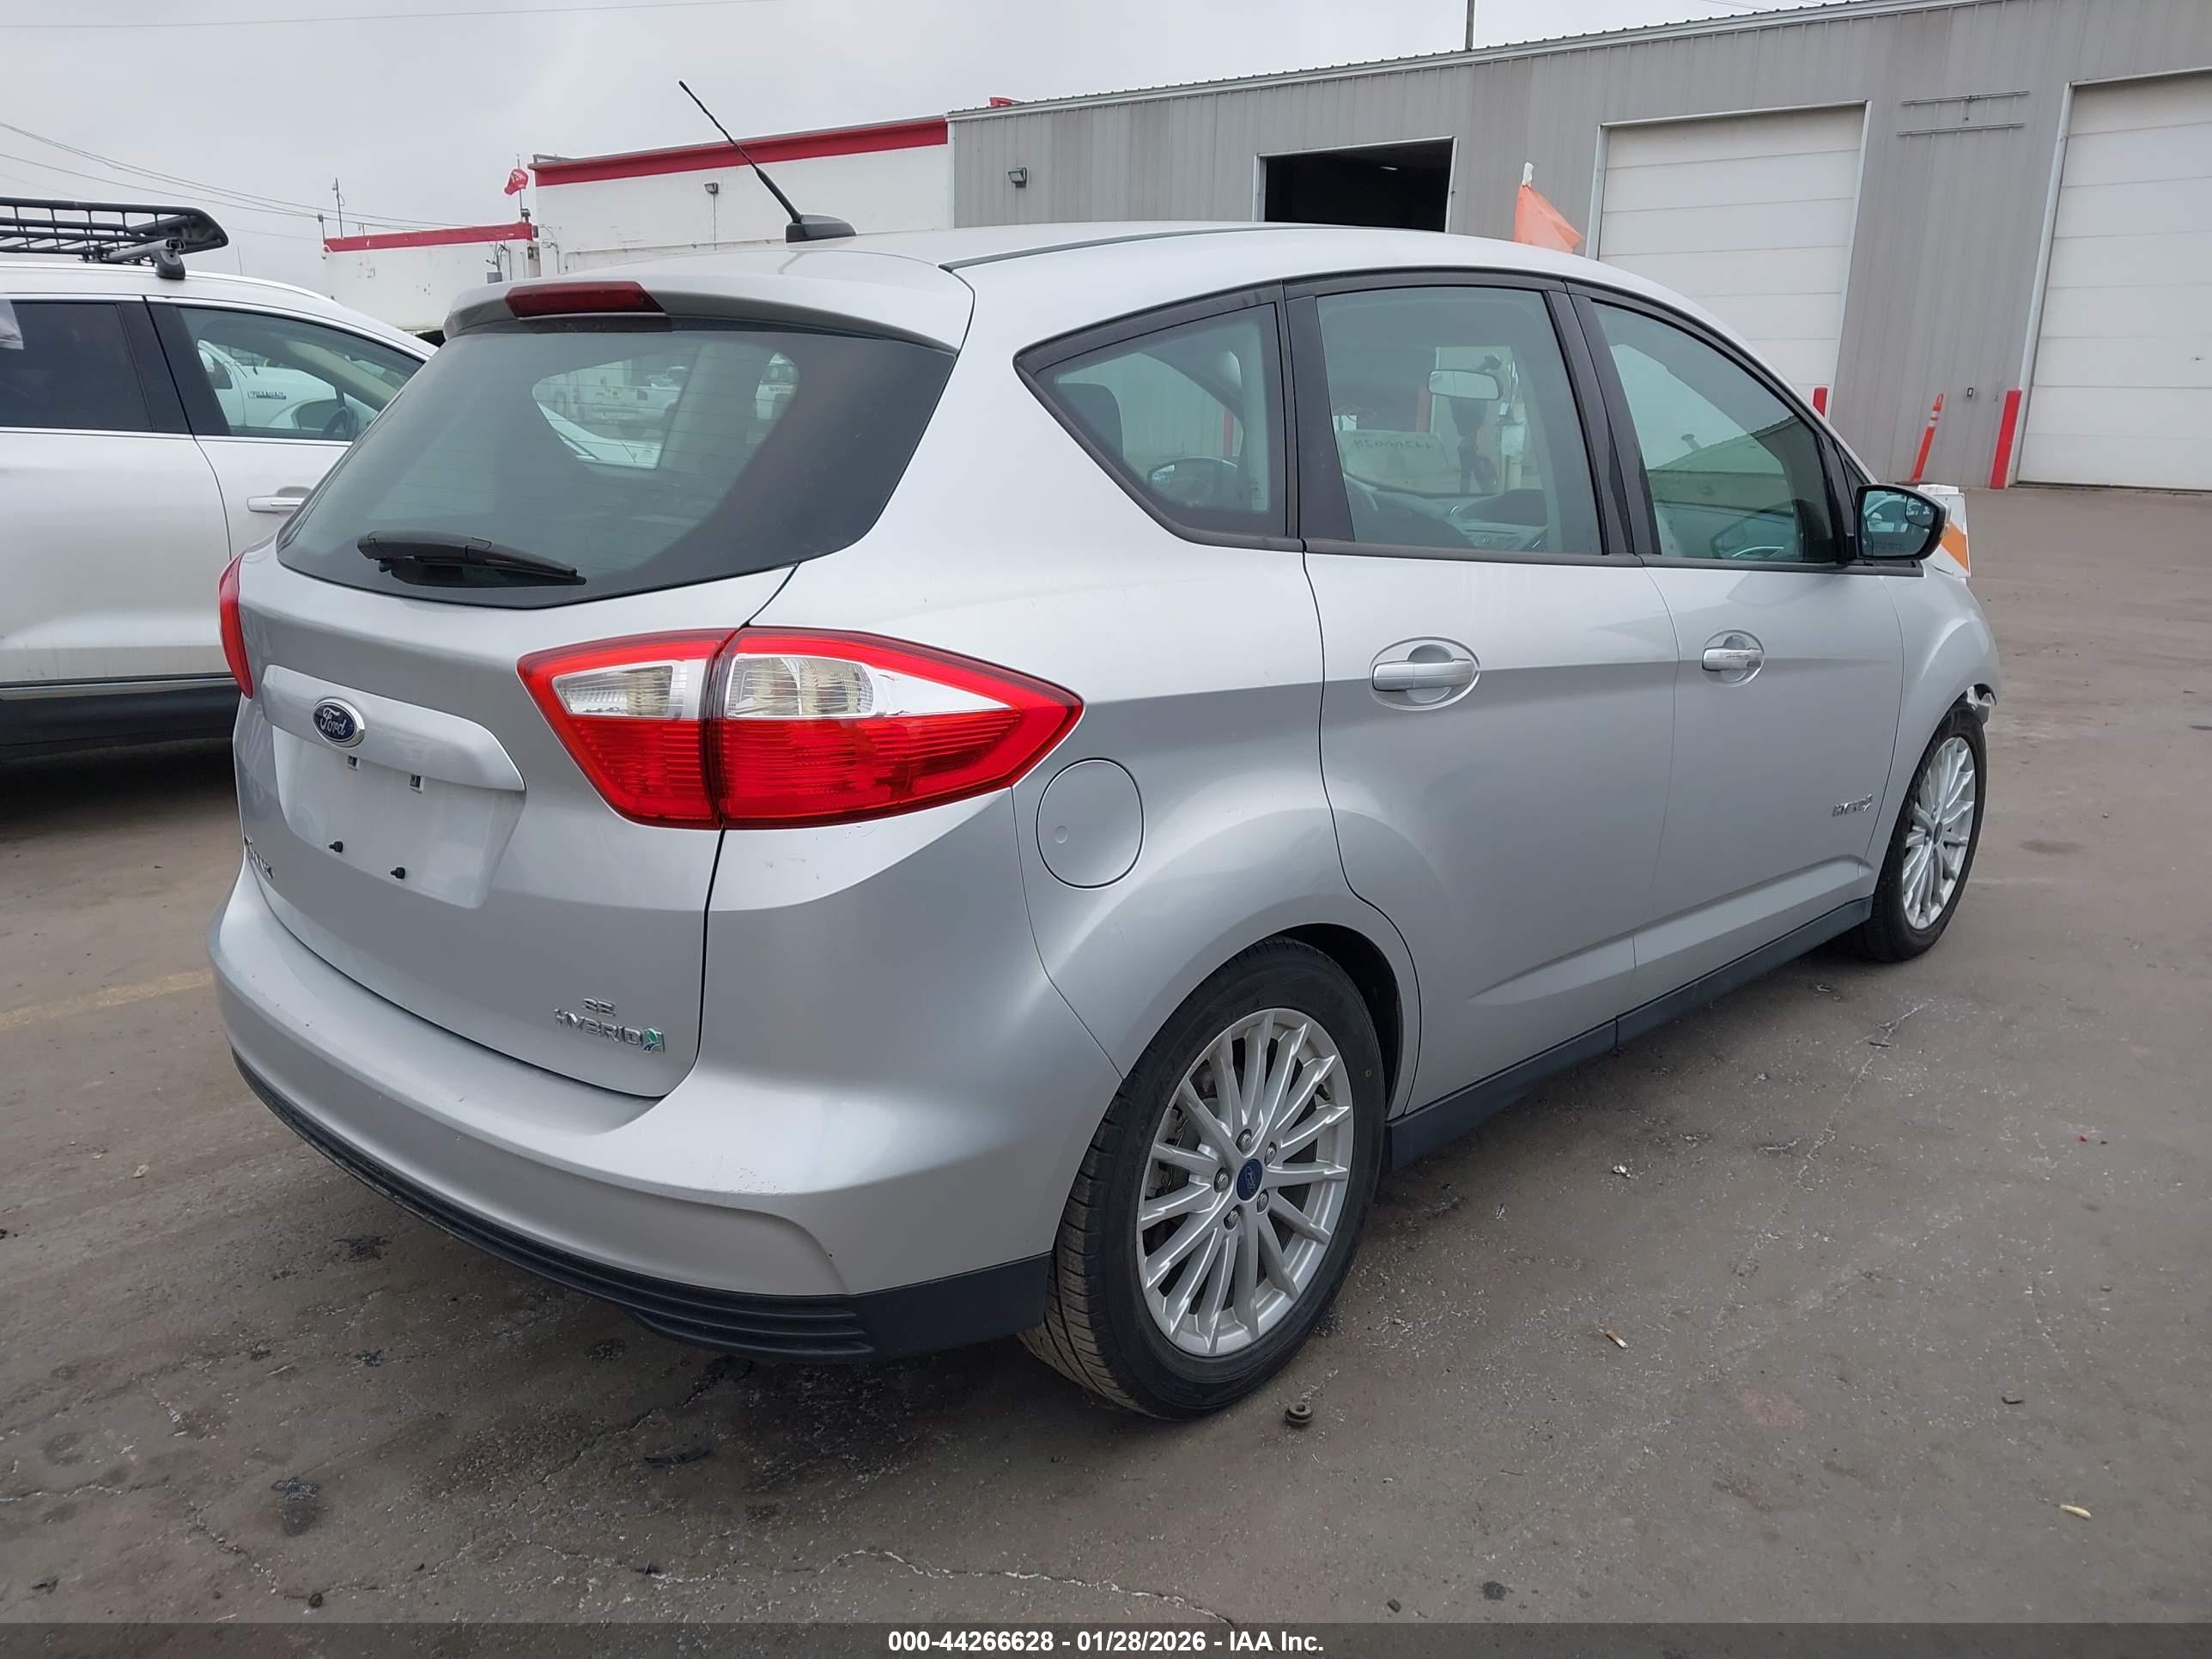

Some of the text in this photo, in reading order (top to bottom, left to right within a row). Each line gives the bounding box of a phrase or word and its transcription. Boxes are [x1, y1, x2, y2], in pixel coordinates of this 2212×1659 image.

[320, 708, 347, 736] Ford
[582, 997, 617, 1017] SE
[553, 1008, 644, 1046] HYBRID
